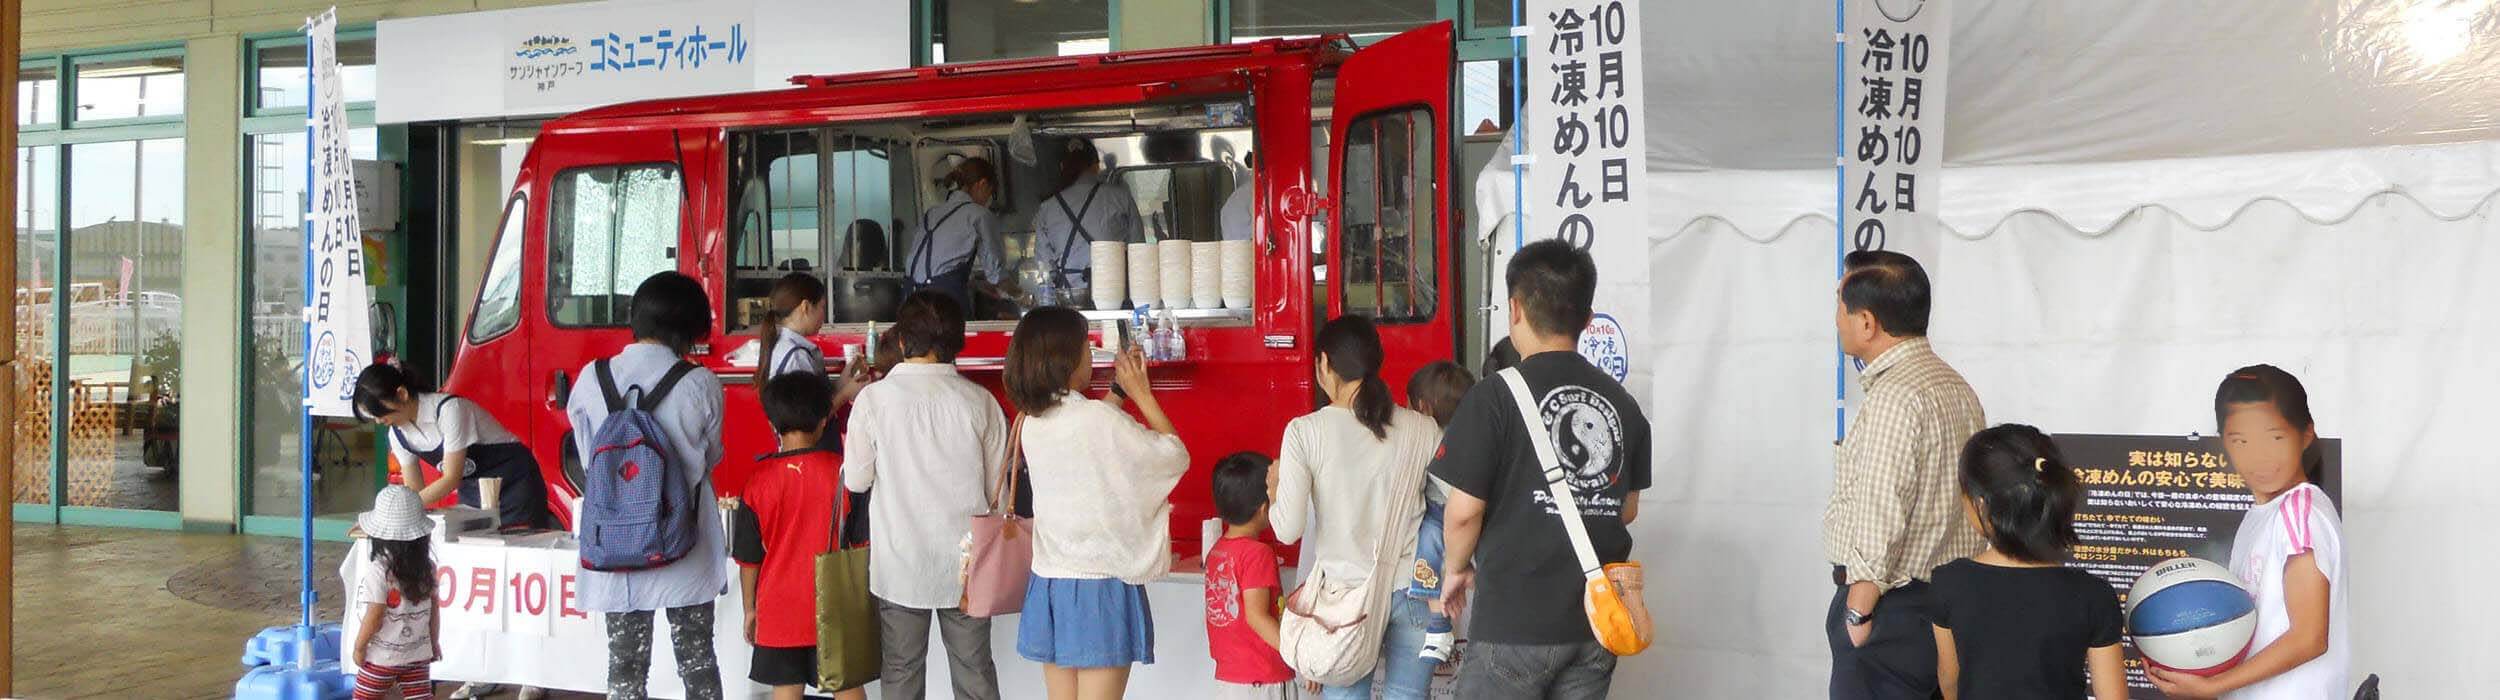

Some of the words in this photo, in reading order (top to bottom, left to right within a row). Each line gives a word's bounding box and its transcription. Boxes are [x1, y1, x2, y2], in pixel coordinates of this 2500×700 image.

[510, 61, 584, 80] サンシャインワーフ
[590, 24, 748, 71] コミュニティホール
[1589, 1, 1629, 203] 10月10日
[1894, 32, 1930, 213] 10月10日
[437, 565, 588, 620] 0月10日
